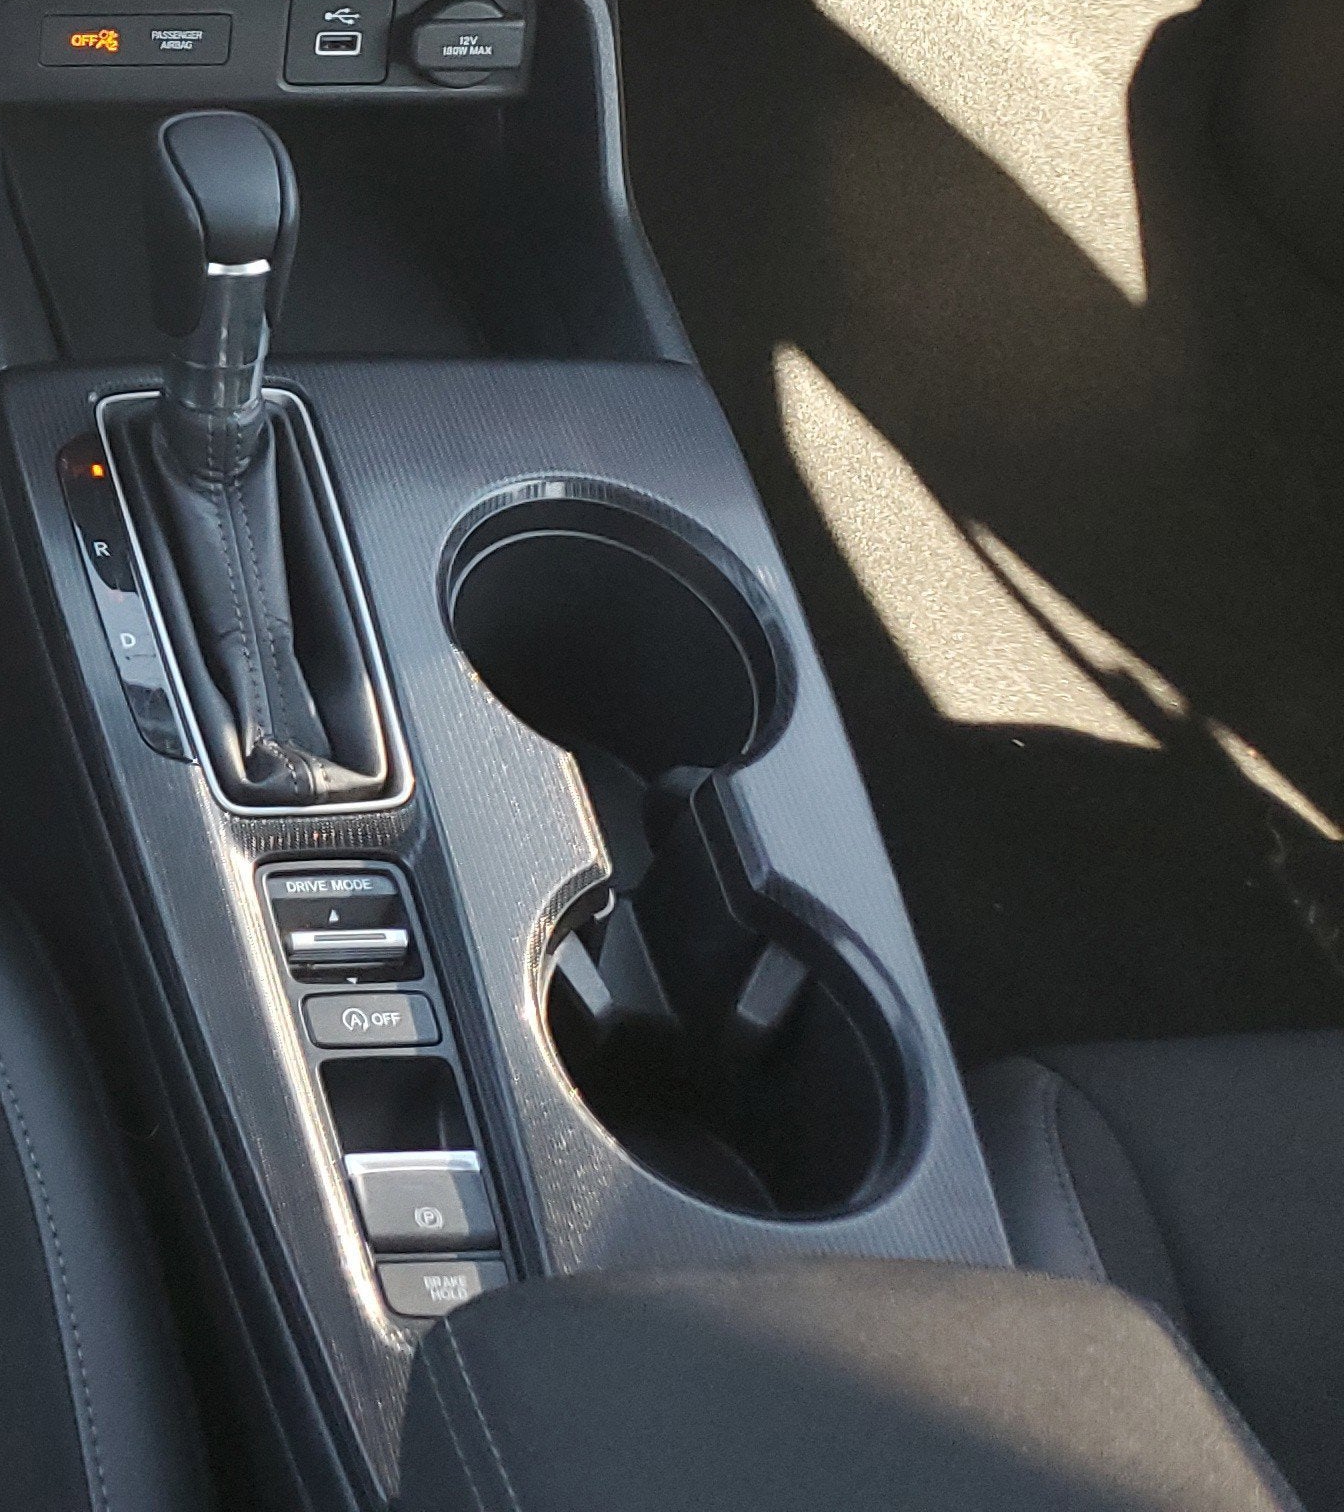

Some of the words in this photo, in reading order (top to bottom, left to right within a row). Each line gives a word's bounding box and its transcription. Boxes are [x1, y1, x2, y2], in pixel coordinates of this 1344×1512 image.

[71, 34, 98, 47] OFF
[151, 30, 203, 40] PASSENGER
[459, 35, 479, 46] 12V
[159, 40, 193, 50] AIRBAG
[469, 45, 492, 55] MAX
[93, 541, 111, 557] R
[119, 632, 137, 649] D
[285, 880, 327, 893] DRIVE
[330, 879, 374, 892] MODE
[370, 1012, 401, 1027] OFF
[423, 1275, 467, 1288] BRAKE
[430, 1288, 468, 1302] HOLD
